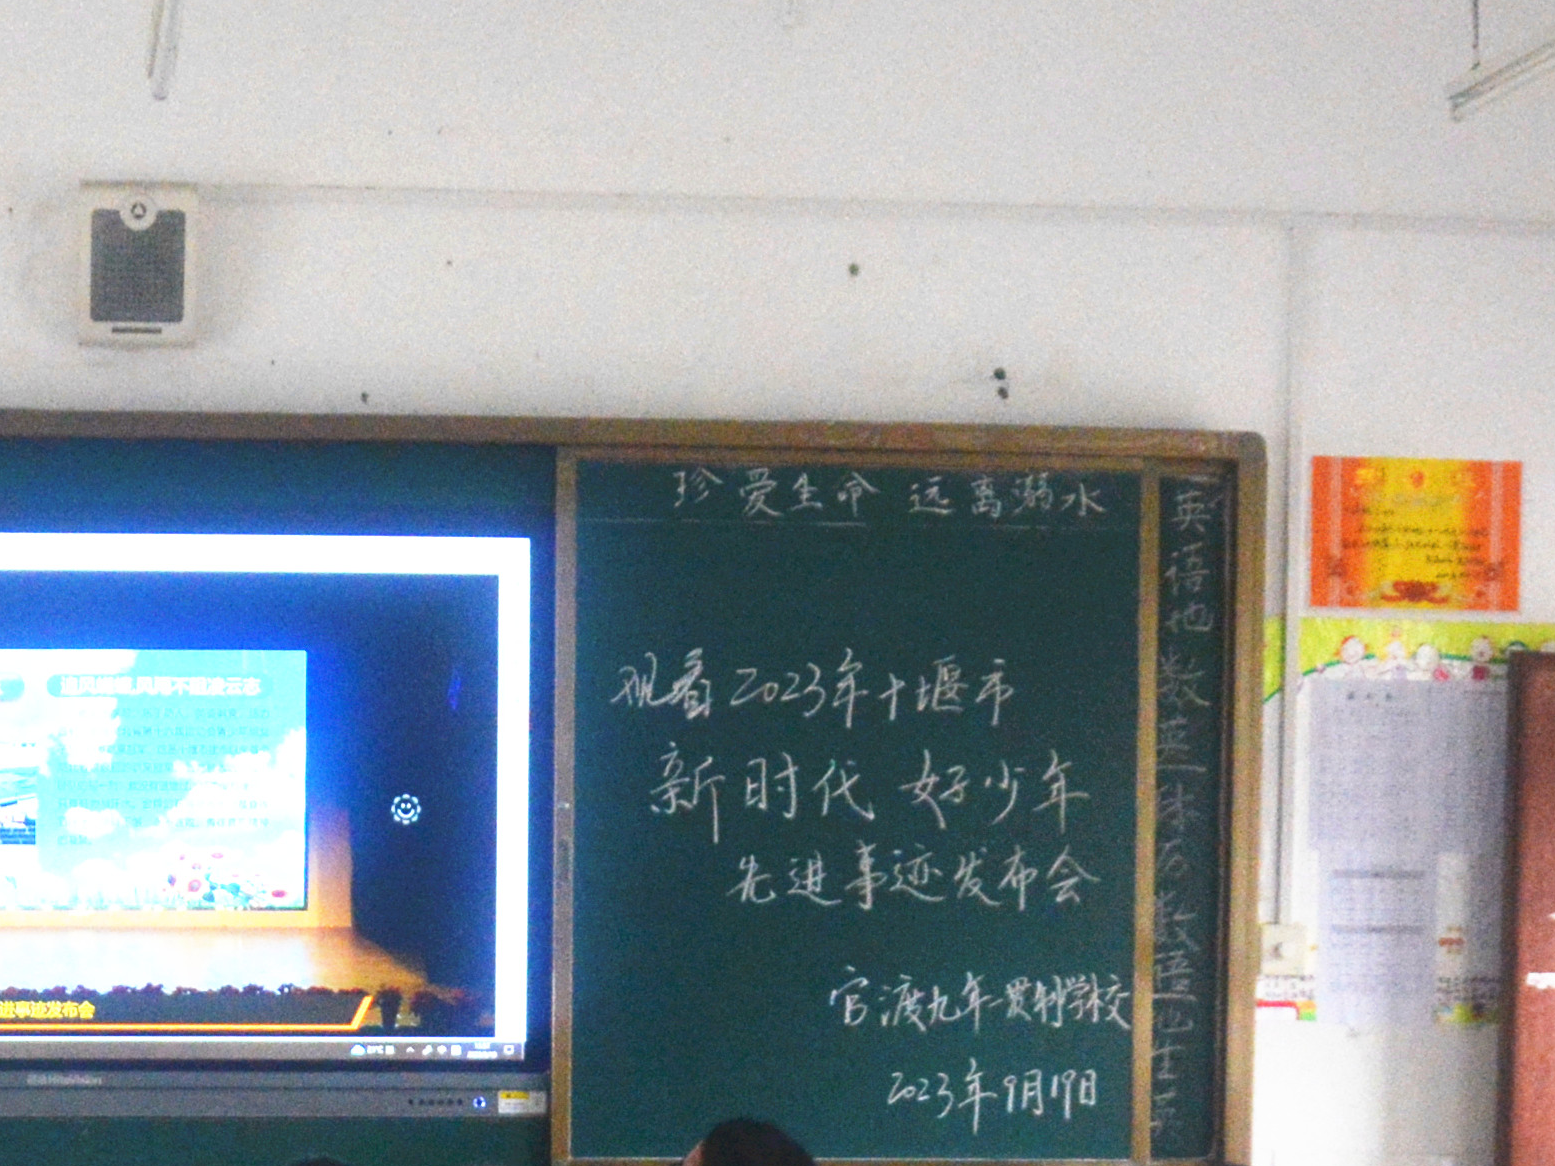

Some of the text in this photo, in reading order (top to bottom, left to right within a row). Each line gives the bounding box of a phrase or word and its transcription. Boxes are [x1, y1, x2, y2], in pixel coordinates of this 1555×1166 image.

[672, 467, 880, 517] 珍爱生命
[610, 647, 1015, 728] 观看2023年十堰市
[649, 742, 1090, 843] 新时代 好少年
[726, 841, 1100, 911] 先进事迹发布会
[829, 965, 1132, 1034] 官渡九年一贯制学校
[887, 1057, 1097, 1136] 2023年9月19日
